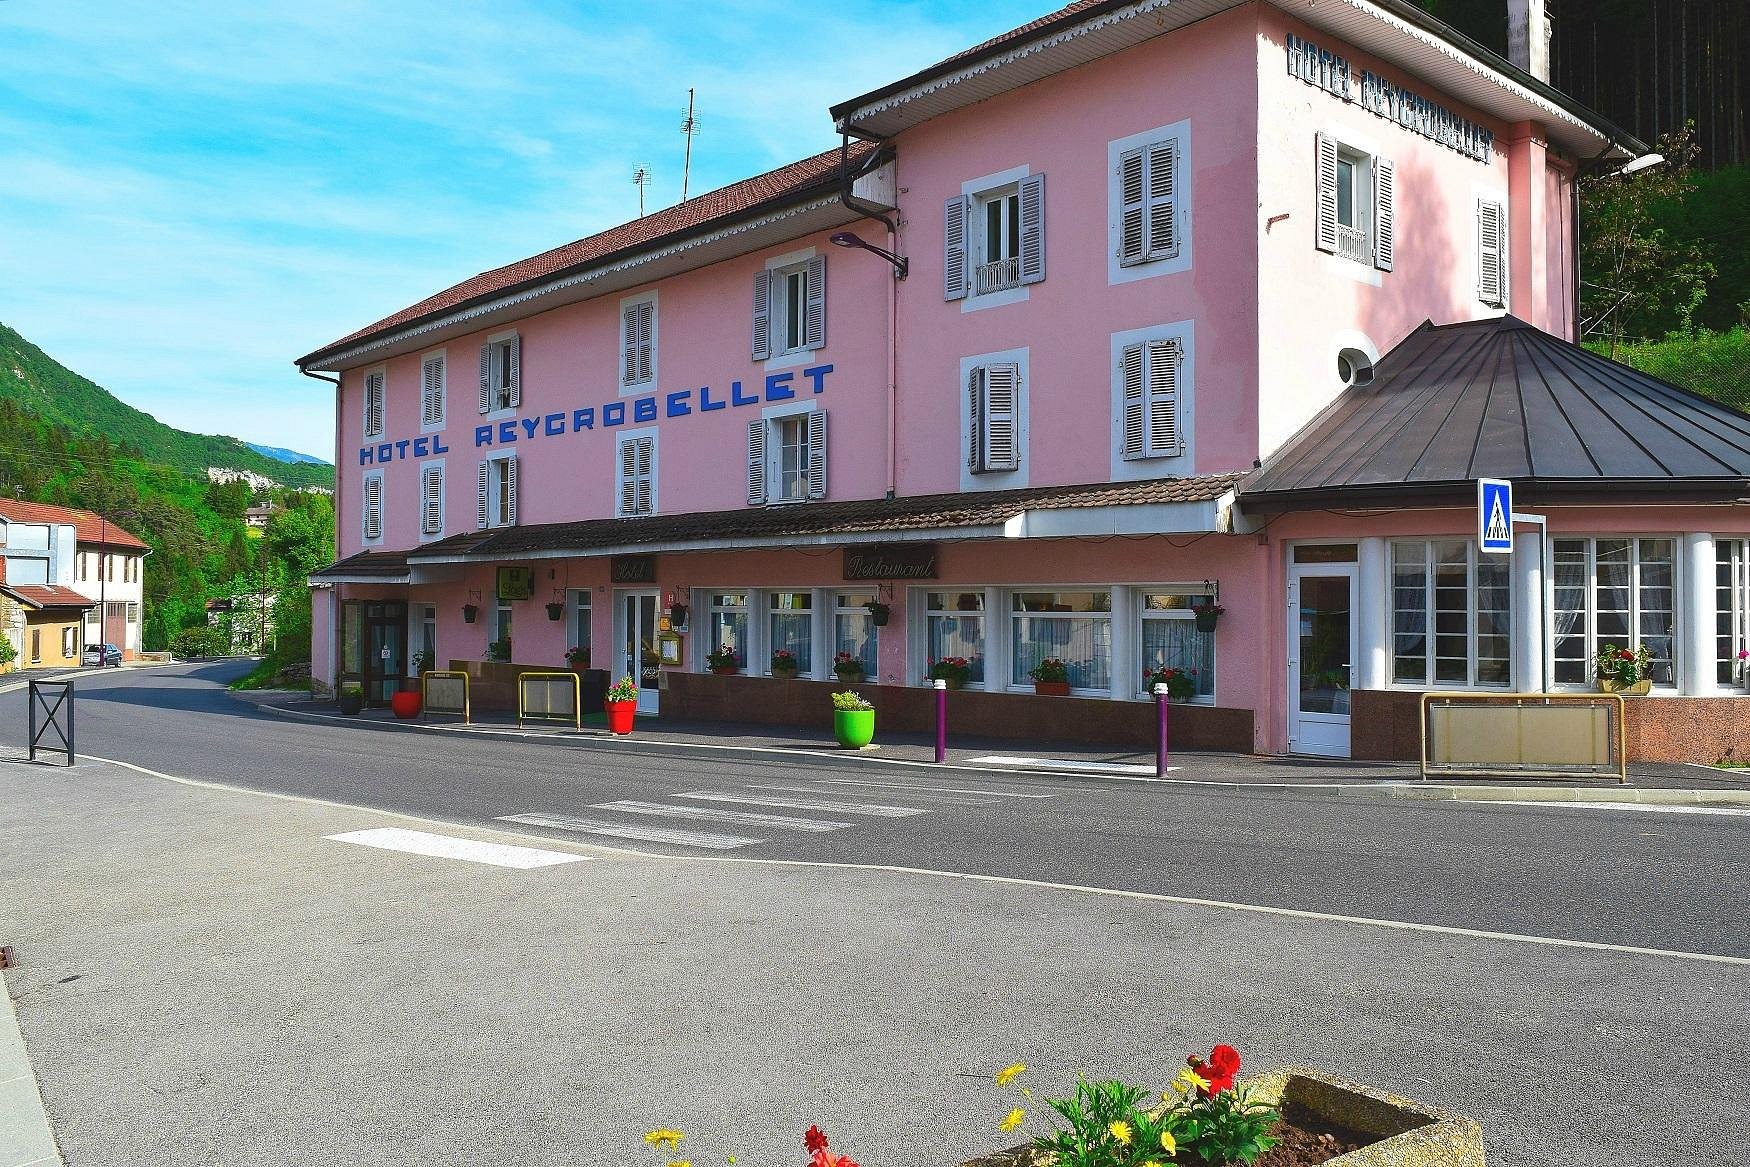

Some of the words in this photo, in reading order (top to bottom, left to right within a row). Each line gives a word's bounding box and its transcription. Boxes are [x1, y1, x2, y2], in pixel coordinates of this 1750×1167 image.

[1286, 32, 1351, 103] HOTEL
[360, 434, 449, 466] HOTEL
[475, 364, 834, 447] REYGROBELLET
[847, 555, 935, 577] Restaurant
